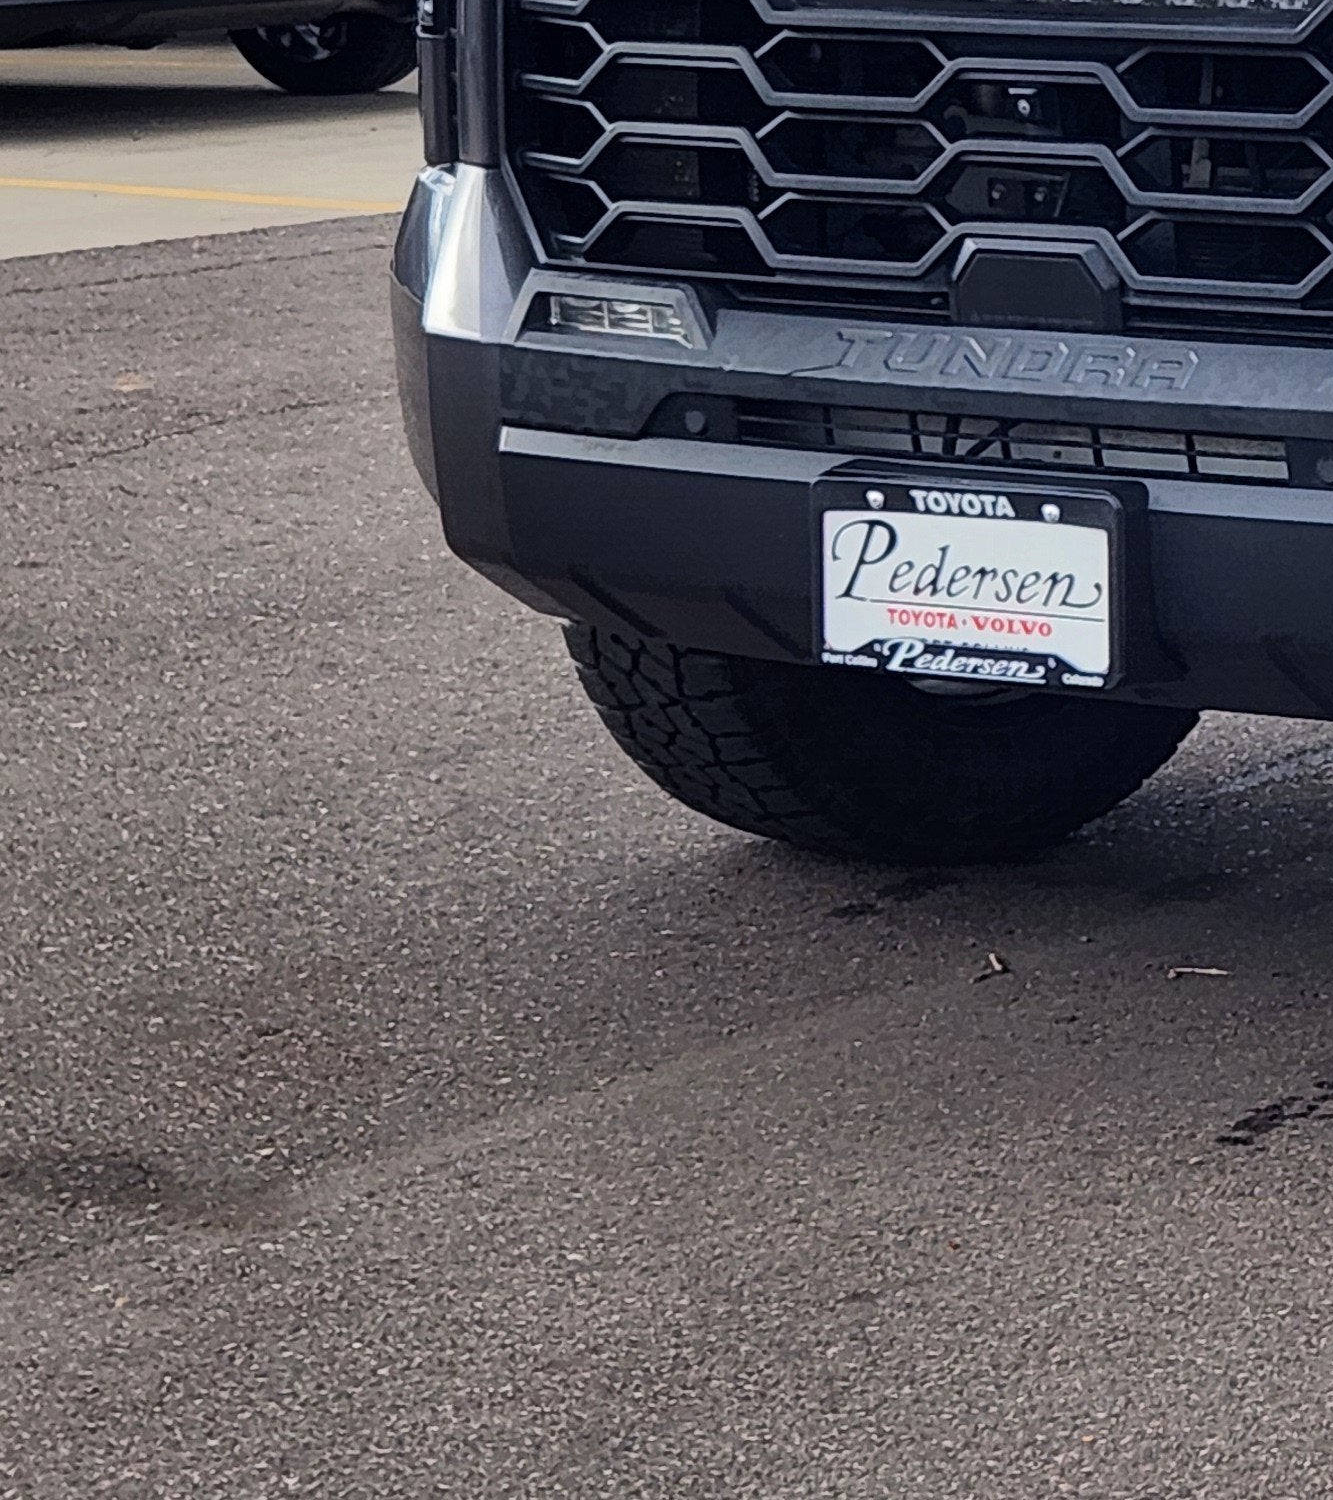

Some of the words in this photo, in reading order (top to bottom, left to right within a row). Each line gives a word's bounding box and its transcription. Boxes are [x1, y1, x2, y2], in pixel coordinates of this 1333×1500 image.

[837, 327, 1200, 391] TUNDRA
[908, 489, 1016, 517] TOYOTA
[831, 518, 1103, 609] Pedersen
[886, 607, 957, 630] TOYOTA
[969, 615, 1054, 638] VOLVO
[881, 637, 1047, 681] Pedersen
